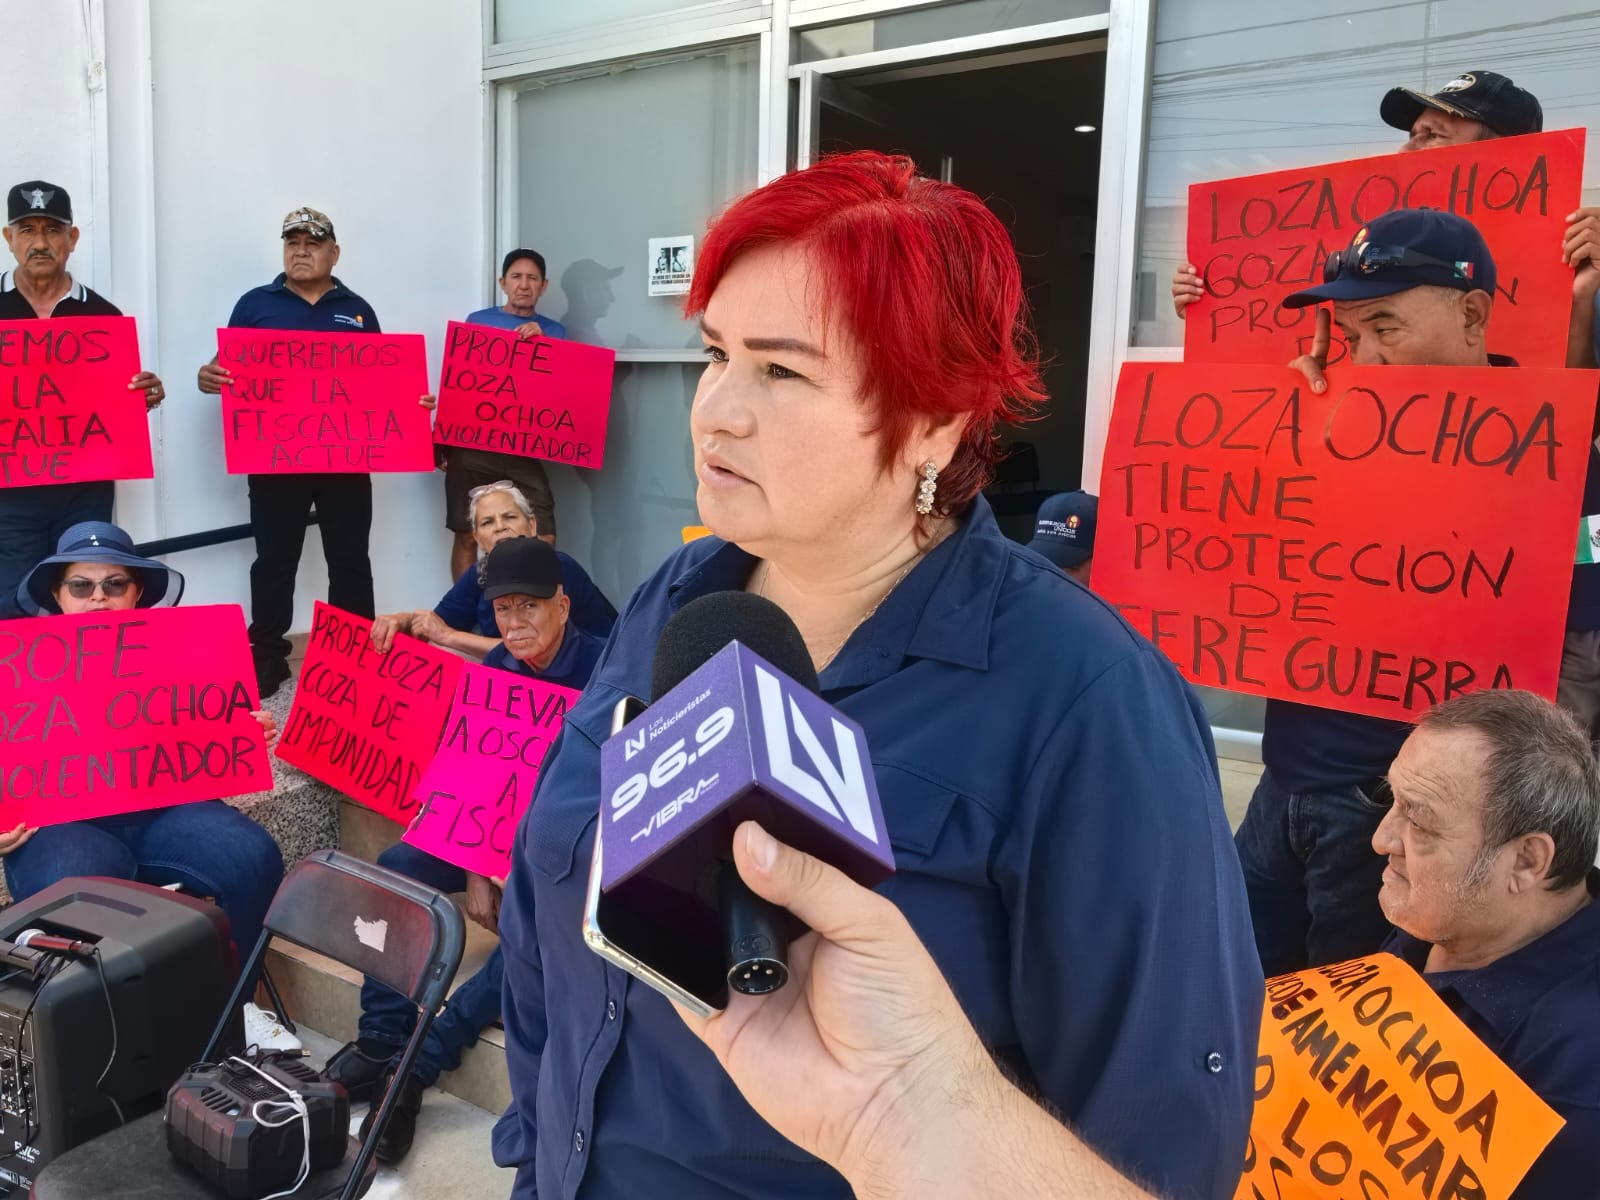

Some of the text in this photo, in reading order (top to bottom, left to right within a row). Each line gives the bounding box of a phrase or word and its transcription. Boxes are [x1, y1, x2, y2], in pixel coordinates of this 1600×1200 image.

[1210, 154, 1549, 246] LOZA OCHOA
[225, 338, 401, 370] QUEREMOS
[450, 327, 553, 374] PROFE
[12, 373, 66, 409] LA
[229, 374, 352, 404] QUE LA
[444, 365, 518, 400] LOZA
[233, 409, 404, 441] FISCALIA
[475, 401, 576, 432] OCHOA
[1133, 372, 1563, 481] LOZA OCHOA
[271, 444, 386, 470] ACTUE
[438, 422, 592, 465] VIOLENTADOR
[1114, 464, 1318, 527] TIENE
[1229, 583, 1336, 625] DE
[312, 607, 444, 700] PROFE LOZA
[106, 681, 254, 730] OCHOA
[371, 694, 410, 741] DE
[649, 687, 712, 741] Noticieristas
[448, 715, 469, 753] A
[283, 706, 421, 811] IMPUNIDAD
[610, 706, 735, 823] 96.9
[495, 771, 519, 818] A
[630, 772, 720, 844] VIBRA
[1353, 986, 1499, 1164] OCHOA
[1279, 1007, 1487, 1200] AMENAZAR
